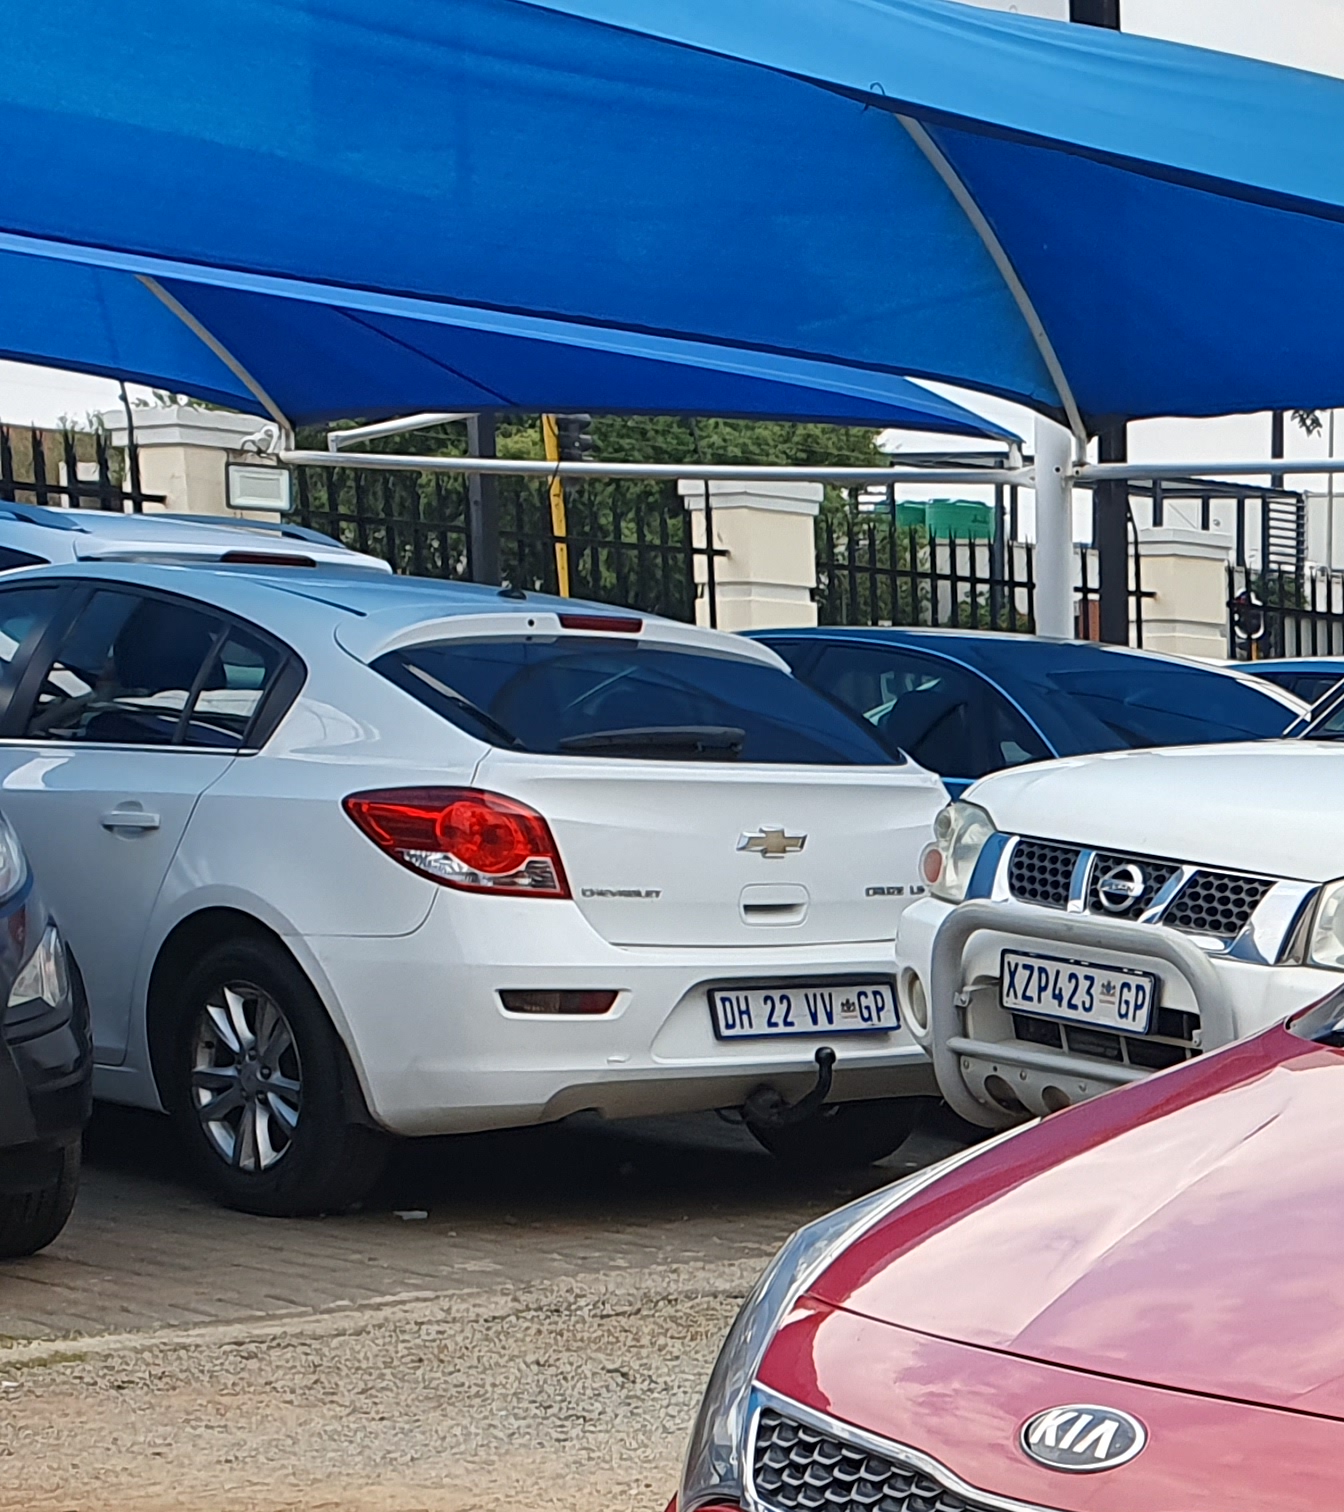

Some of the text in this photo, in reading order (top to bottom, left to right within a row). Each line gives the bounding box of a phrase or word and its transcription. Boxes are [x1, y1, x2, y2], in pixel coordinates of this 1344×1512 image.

[719, 990, 886, 1030] DH 22 VV GP
[1006, 959, 1148, 1023] XZP423 GP
[1029, 1409, 1120, 1459] KIA
